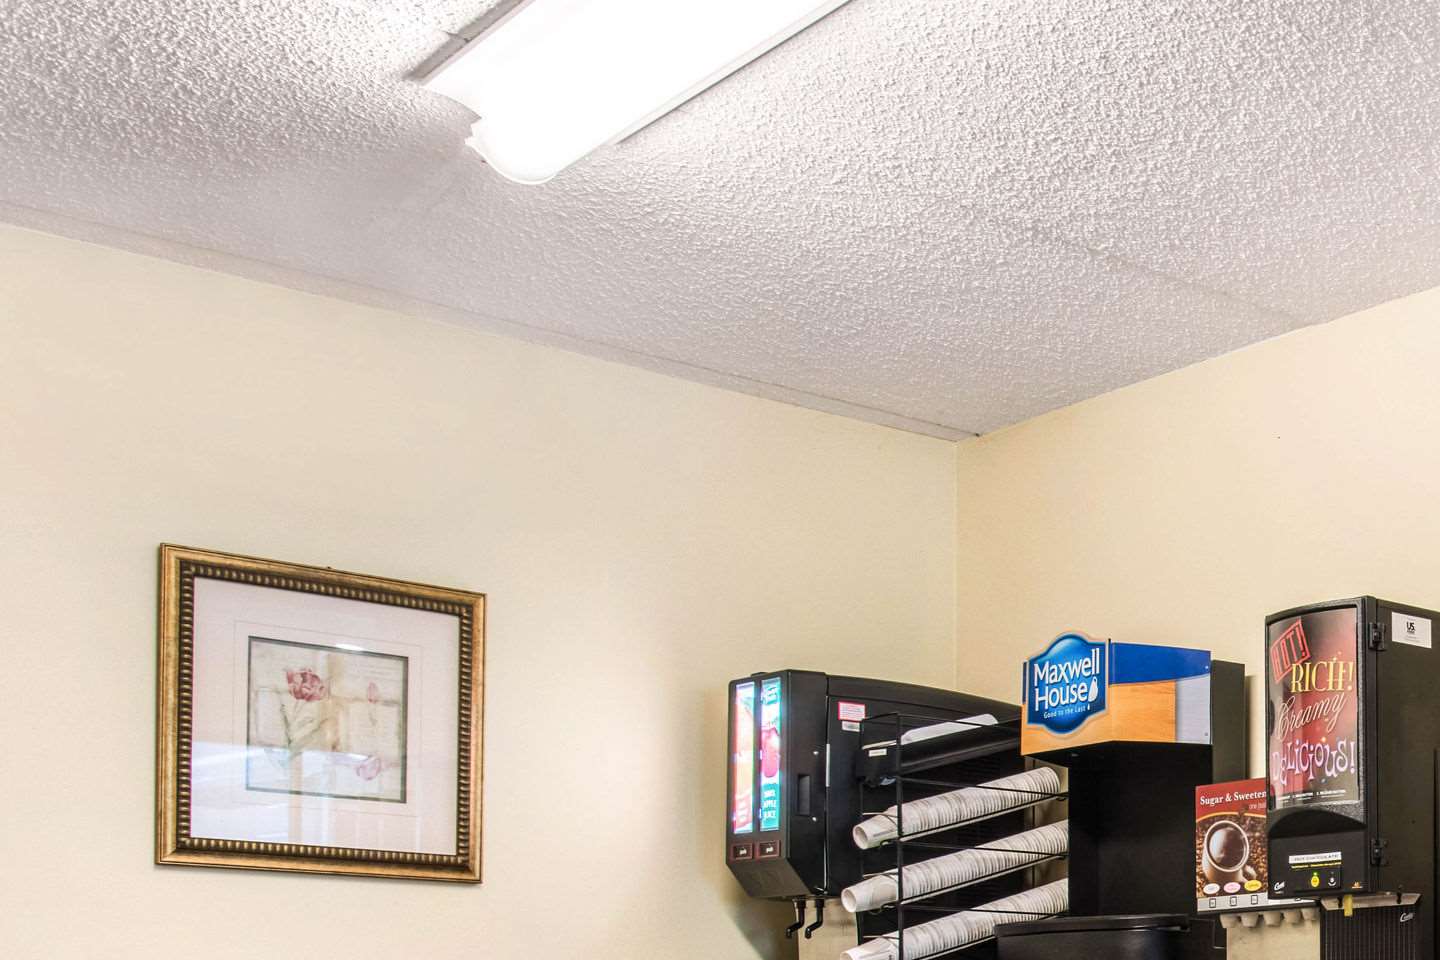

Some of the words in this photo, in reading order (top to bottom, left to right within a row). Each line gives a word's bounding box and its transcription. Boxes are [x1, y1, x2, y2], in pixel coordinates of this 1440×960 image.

[1034, 648, 1100, 687] Maxwell
[1291, 660, 1354, 693] RICH!
[1034, 682, 1088, 711] House
[1277, 692, 1347, 740] Creamy
[1200, 795, 1223, 806] Sugar
[1225, 792, 1232, 802] &
